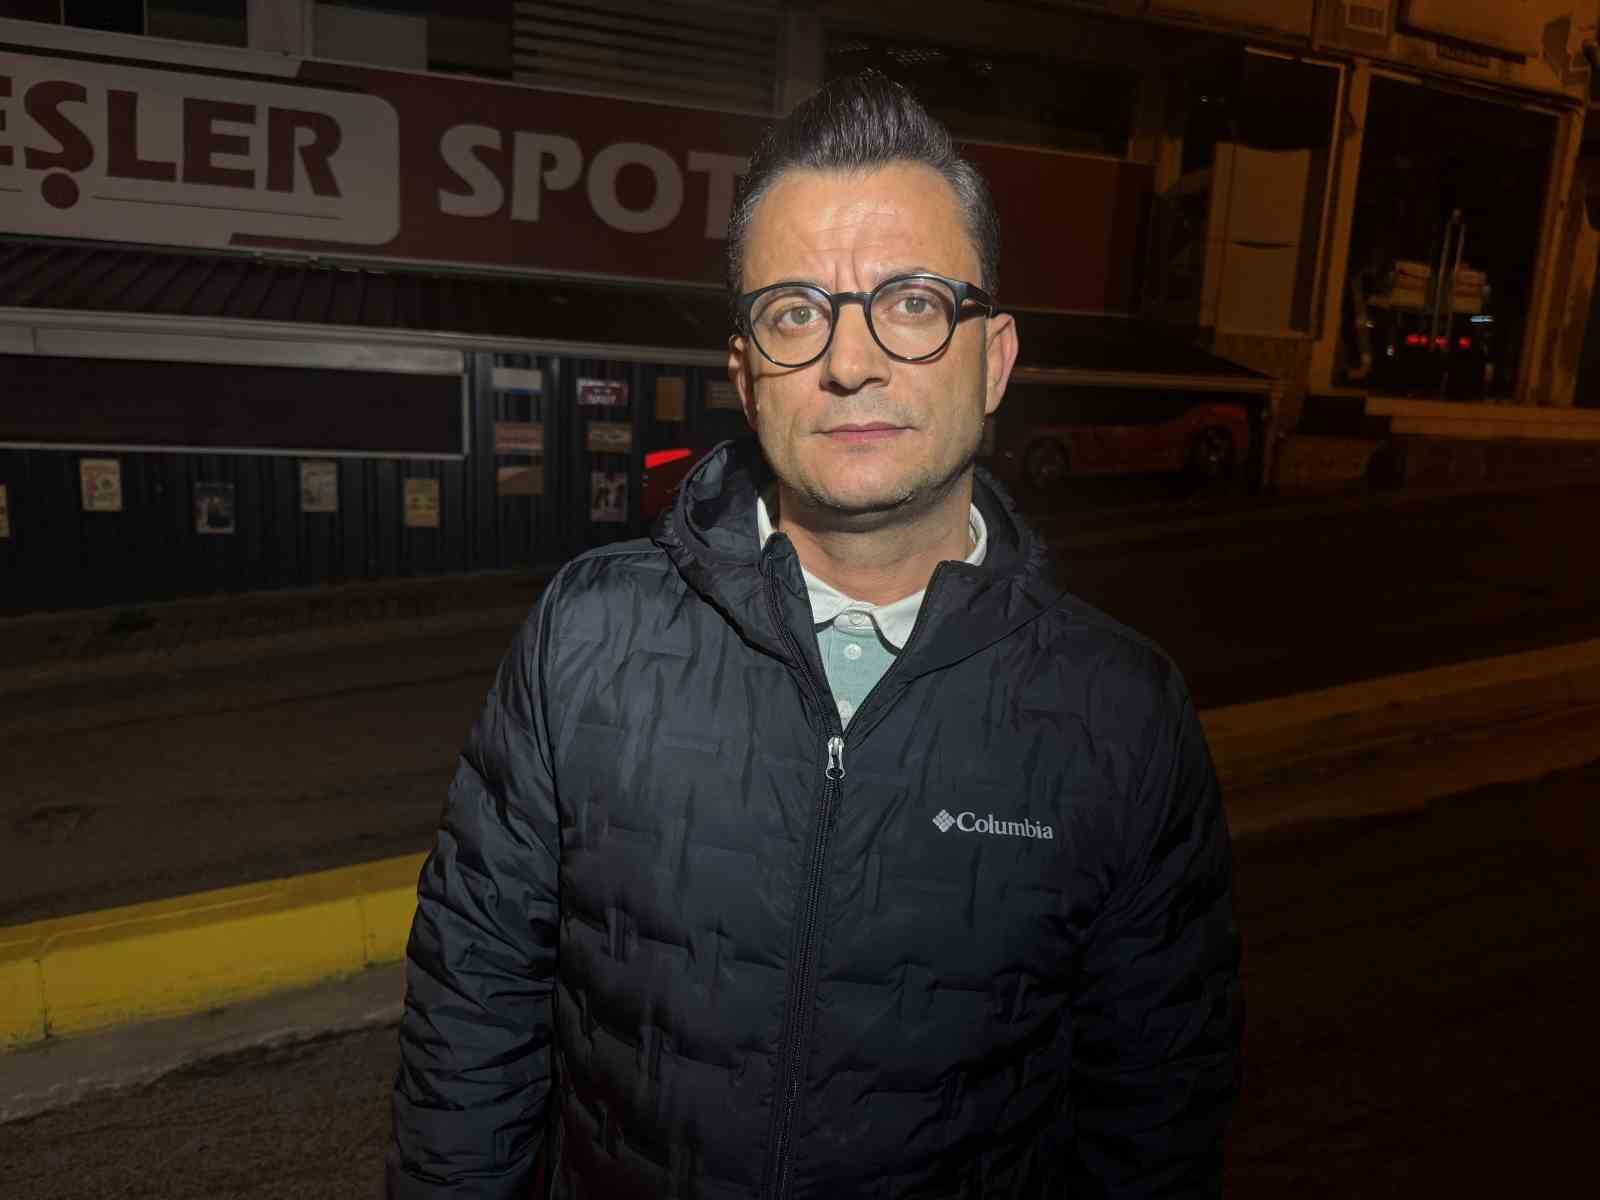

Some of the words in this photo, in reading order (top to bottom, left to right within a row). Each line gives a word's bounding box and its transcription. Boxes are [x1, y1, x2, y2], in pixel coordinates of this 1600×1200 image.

[0, 75, 341, 210] ŞLER
[438, 123, 752, 240] SPOT
[956, 811, 1054, 840] Columbia
